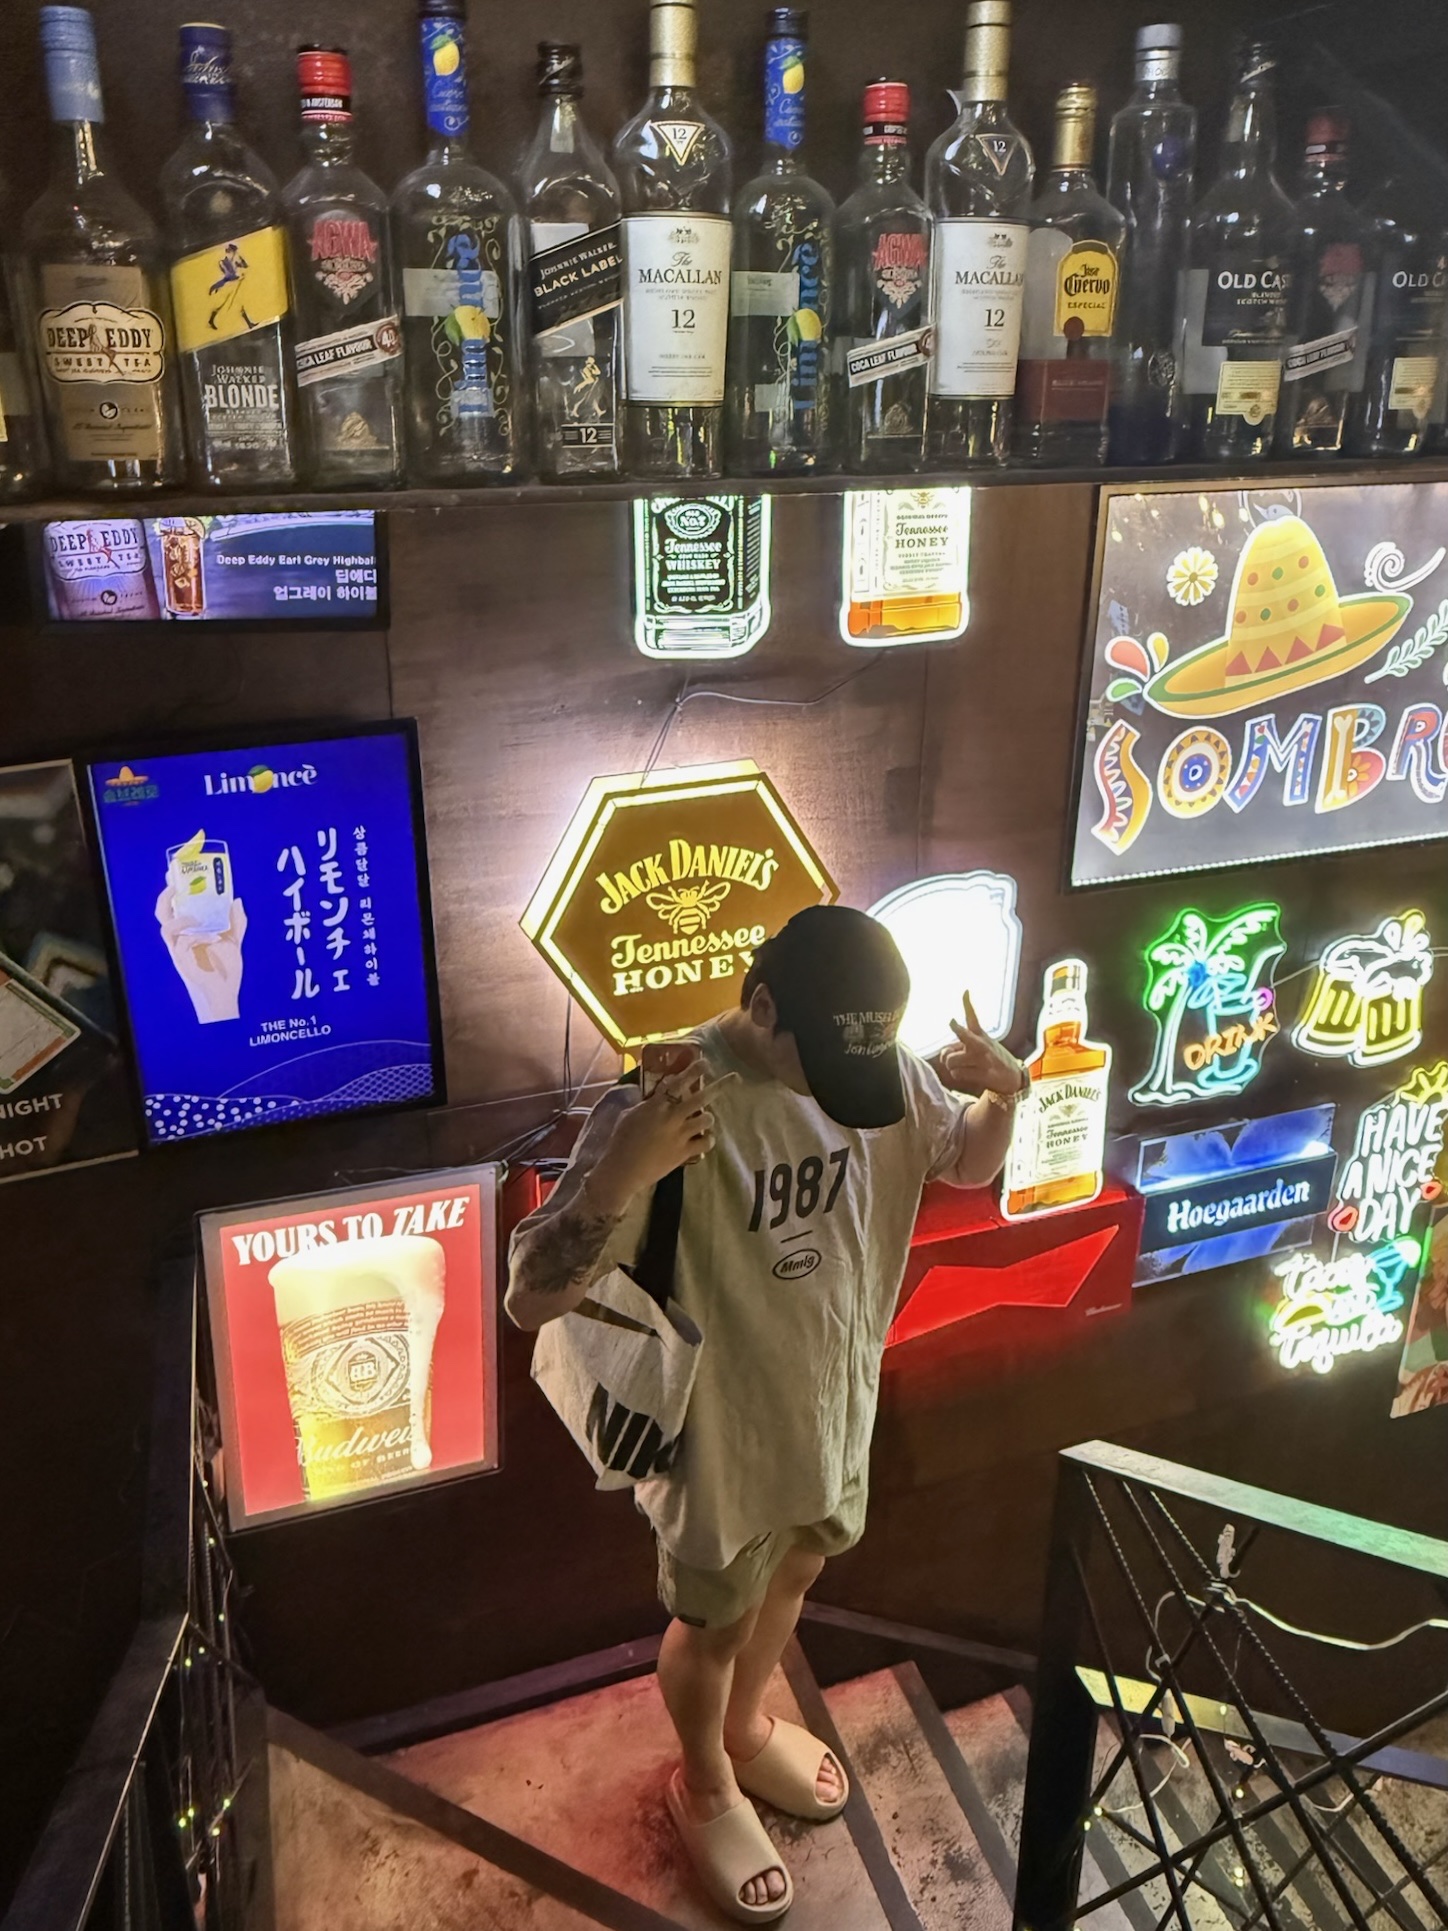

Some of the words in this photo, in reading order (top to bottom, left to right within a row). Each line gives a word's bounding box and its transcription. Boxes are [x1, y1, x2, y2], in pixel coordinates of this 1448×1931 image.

[672, 127, 687, 140] 12
[993, 140, 1006, 153] 12
[533, 271, 579, 297] BLACK
[580, 254, 624, 278] LABEL
[638, 268, 722, 285] MACALLAN
[1064, 273, 1111, 297] Cuervo
[1217, 270, 1257, 290] OLD
[1392, 270, 1429, 289] OLD
[671, 309, 696, 329] 12
[984, 308, 1005, 328] 12
[47, 326, 88, 348] DEEP
[105, 327, 152, 348] EDDY
[314, 348, 335, 365] LEAF
[850, 358, 870, 373] COCA
[869, 353, 887, 367] LEAF
[205, 383, 280, 409] BLONDE
[580, 427, 598, 444] 12
[895, 522, 948, 537] Tennessee
[49, 533, 87, 553] DEEP
[99, 527, 139, 548] EDDY
[664, 538, 722, 554] Tennessee
[895, 536, 949, 549] HONEY
[216, 554, 246, 566] Deep
[247, 554, 276, 566] Eddy
[278, 554, 301, 565] Earl
[304, 554, 330, 566] Grey
[665, 559, 721, 571] WHISKEY
[1091, 702, 1448, 856] SOMBR
[595, 852, 671, 915] JACK
[669, 838, 780, 892] DANIEL'S
[276, 844, 320, 1000] ハイボール
[610, 924, 766, 969] Tennessee
[260, 1018, 286, 1033] THE
[288, 1014, 318, 1030] No.1
[833, 1012, 858, 1026] THE
[249, 1023, 332, 1047] LIMONCELLO
[1183, 1012, 1278, 1070] DRINK
[1361, 1101, 1448, 1157] HAVE
[1046, 1133, 1088, 1149] HONEY
[1342, 1160, 1364, 1200] A
[1365, 1143, 1443, 1201] NICE
[748, 1146, 850, 1232] 1987
[1167, 1178, 1311, 1234] Hoegaarden
[1354, 1187, 1421, 1242] DAY
[232, 1220, 338, 1266] YOURS
[342, 1212, 383, 1240] TO
[394, 1196, 470, 1236] TAKE
[376, 1447, 410, 1463] BEER
